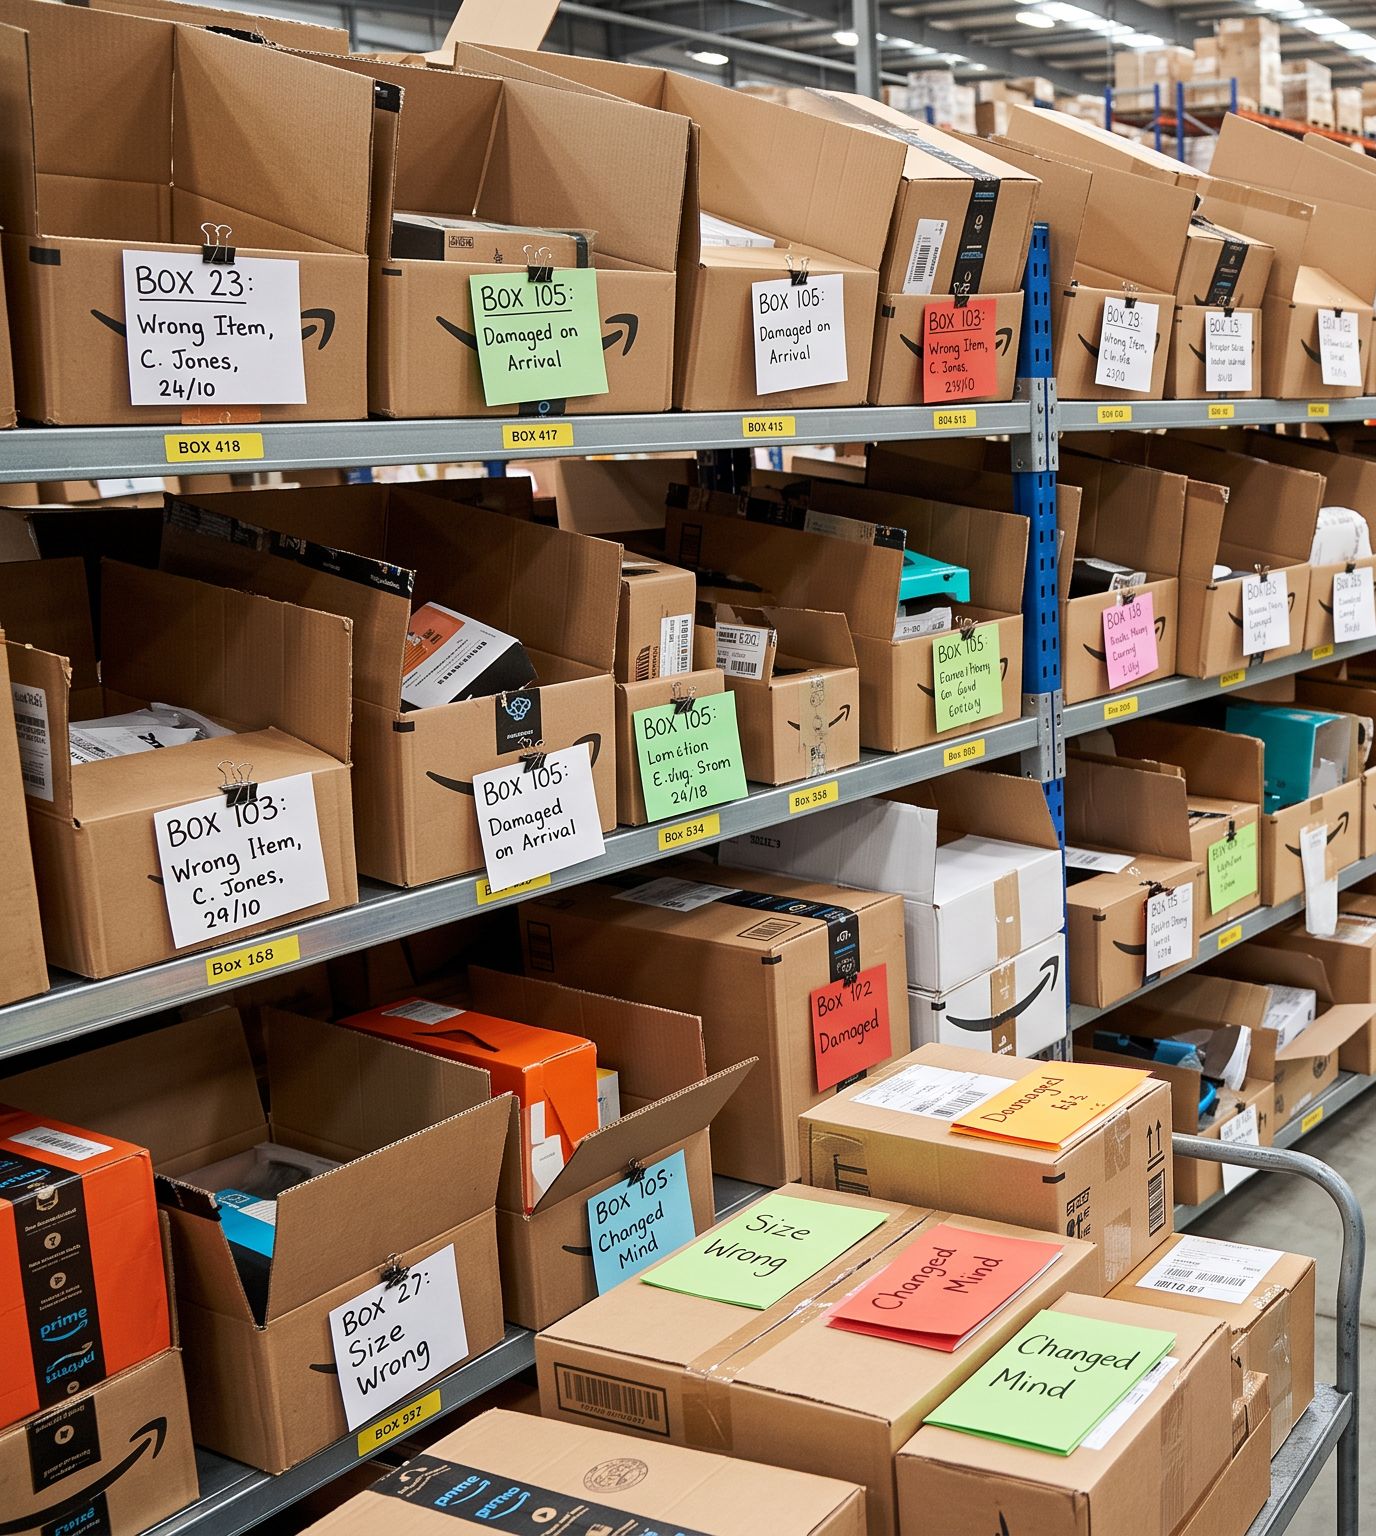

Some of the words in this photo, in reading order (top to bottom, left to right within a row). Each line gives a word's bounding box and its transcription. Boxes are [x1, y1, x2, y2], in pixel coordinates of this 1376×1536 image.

[136, 265, 194, 295] BOX
[209, 269, 253, 297] 23:
[481, 286, 524, 311] BOX
[534, 283, 574, 308] 105:
[759, 292, 789, 315] BOX
[797, 287, 825, 310] 105:
[137, 313, 204, 346] Wrong
[213, 315, 274, 340] Item,
[759, 323, 812, 345] Damaged
[817, 322, 831, 333] on
[929, 311, 955, 331] BOX
[962, 309, 985, 327] 103:
[483, 322, 552, 351] Damaged
[560, 326, 578, 339] on
[929, 342, 960, 360] Wrong
[963, 338, 988, 352] Item,
[140, 349, 162, 369] C.
[172, 348, 239, 373] Jones,
[507, 350, 562, 372] Arrival
[769, 344, 811, 365] Arrival
[158, 377, 216, 400] 24/10
[511, 429, 536, 442] BOX
[538, 429, 558, 441] 417
[748, 422, 767, 433] BOX
[768, 421, 783, 432] 415
[179, 440, 211, 454] BOX
[215, 440, 241, 452] 418
[938, 645, 962, 664] BOX
[644, 717, 678, 740] BOX
[683, 705, 717, 730] 105:
[483, 777, 523, 807] BOX
[531, 763, 569, 791] 105:
[812, 789, 827, 802] 358
[167, 812, 222, 848] BOX
[234, 794, 288, 829] 103:
[488, 797, 563, 837] Damaged
[686, 823, 705, 837] 534
[495, 843, 514, 861] on
[522, 819, 577, 852] Arrival
[171, 853, 240, 884] Wrong
[247, 836, 302, 860] Item,
[192, 887, 215, 904] C.
[220, 870, 284, 898] Jones,
[203, 898, 262, 929] 29/10
[819, 1007, 879, 1054] Damaged
[596, 1192, 631, 1225] BOX
[598, 1200, 664, 1252] Changed
[745, 1213, 811, 1241] Size
[618, 1231, 659, 1269] Mind
[703, 1238, 788, 1278] Wrong
[871, 1246, 957, 1310] Changed
[943, 1256, 1003, 1294] Mind
[342, 1296, 386, 1337] BOX
[397, 1271, 431, 1304] 27:
[40, 1307, 88, 1339] prime
[349, 1324, 406, 1368] Size
[1017, 1334, 1141, 1373] Changed
[356, 1340, 431, 1396] Wrong
[988, 1367, 1076, 1400] Mind
[375, 1417, 399, 1441] BOX
